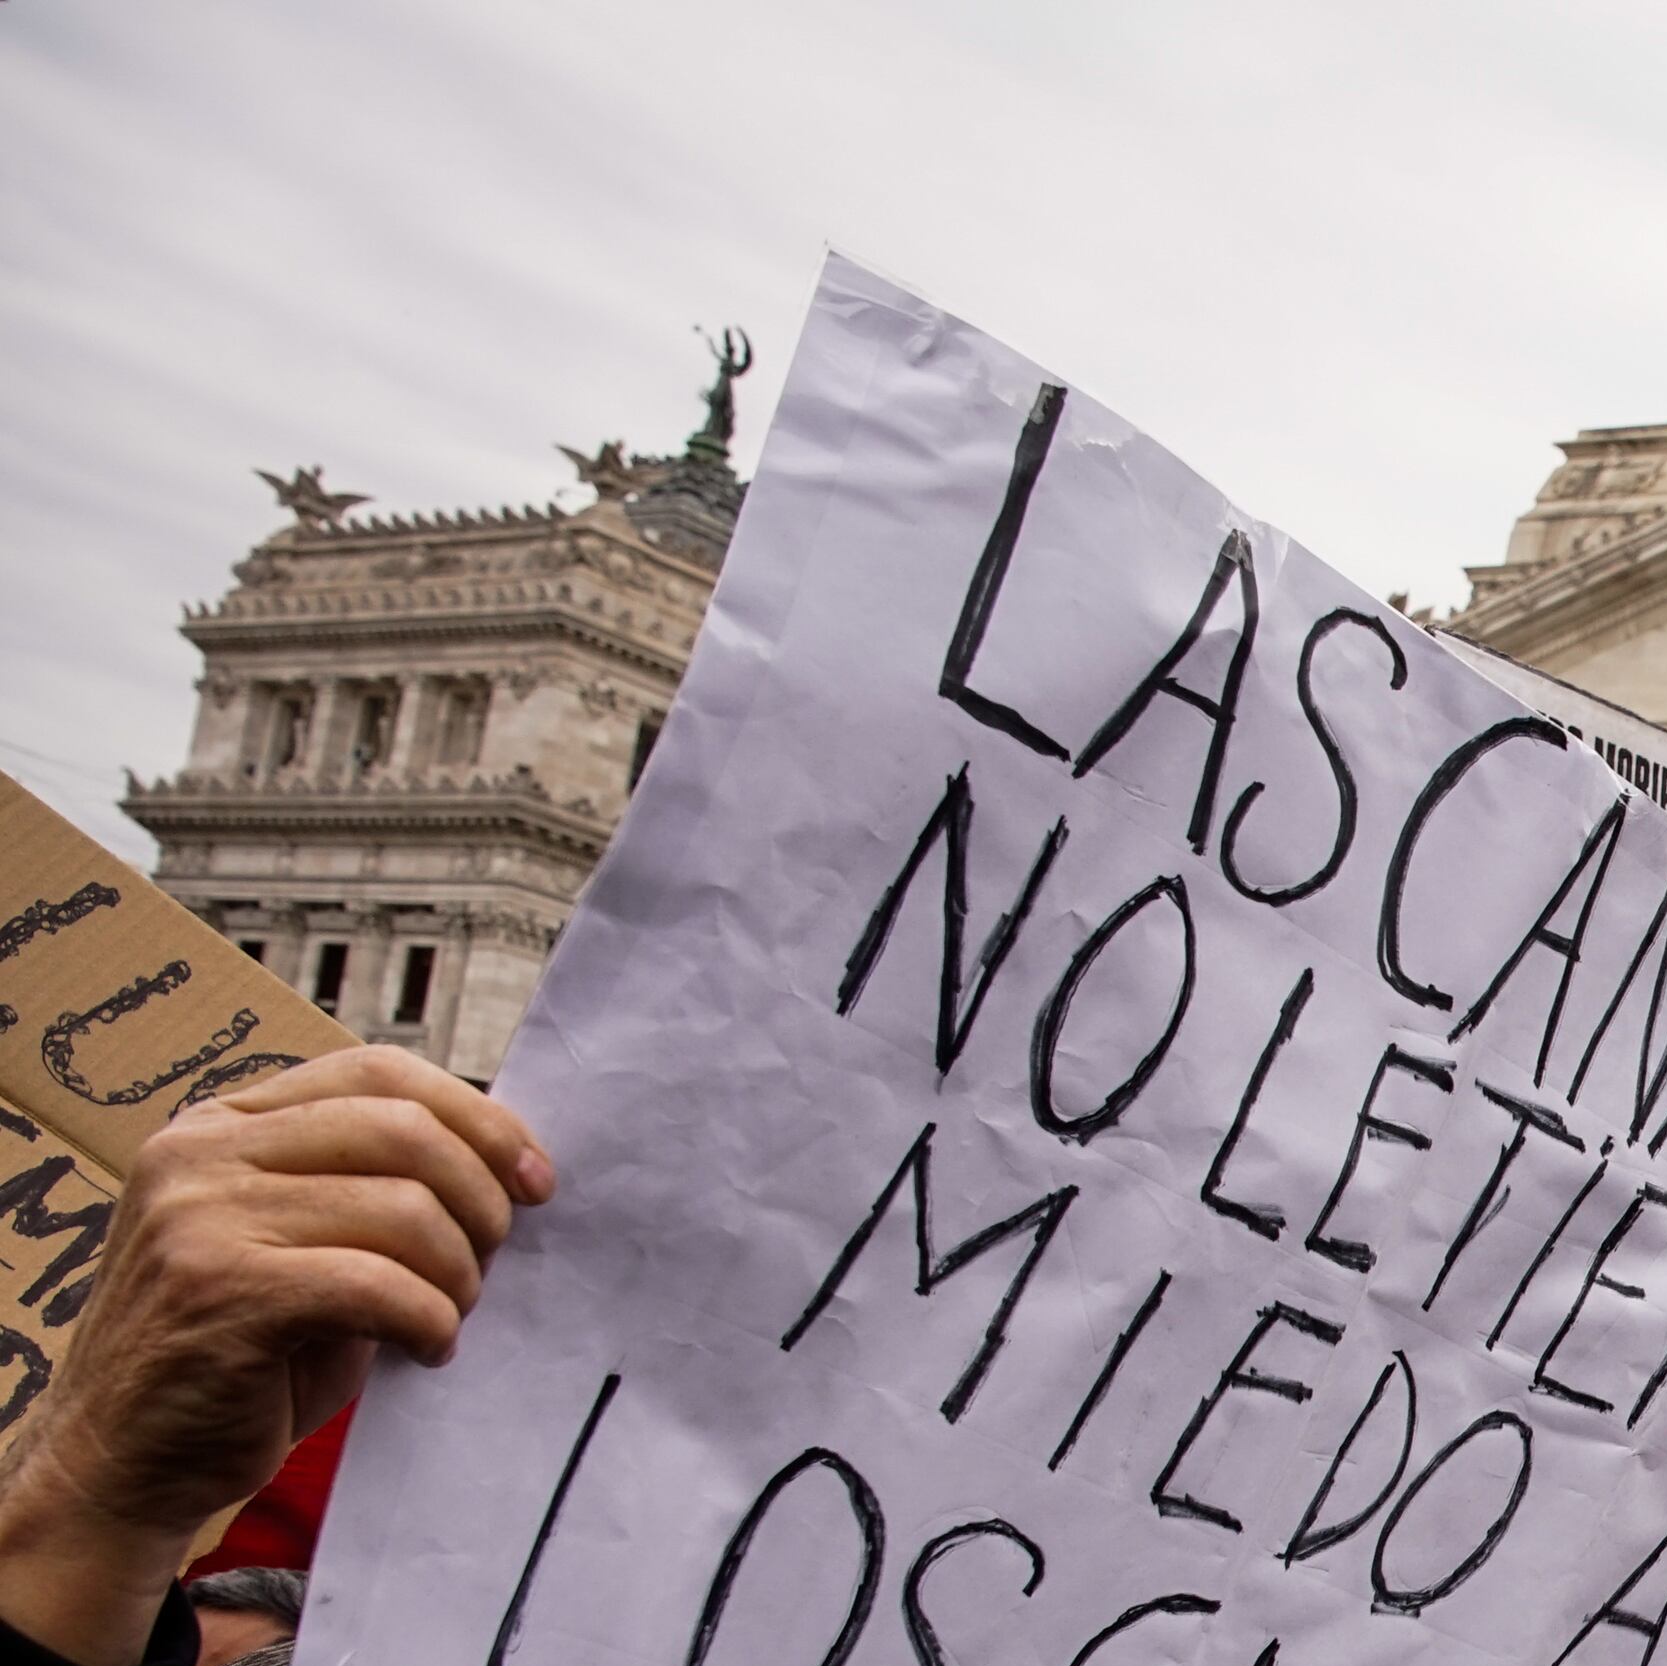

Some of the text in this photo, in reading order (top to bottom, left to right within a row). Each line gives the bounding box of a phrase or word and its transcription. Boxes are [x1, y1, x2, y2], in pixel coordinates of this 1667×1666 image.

[938, 383, 1408, 906] LAS
[837, 762, 1196, 1143] NO
[779, 1122, 1533, 1617] MIEDO
